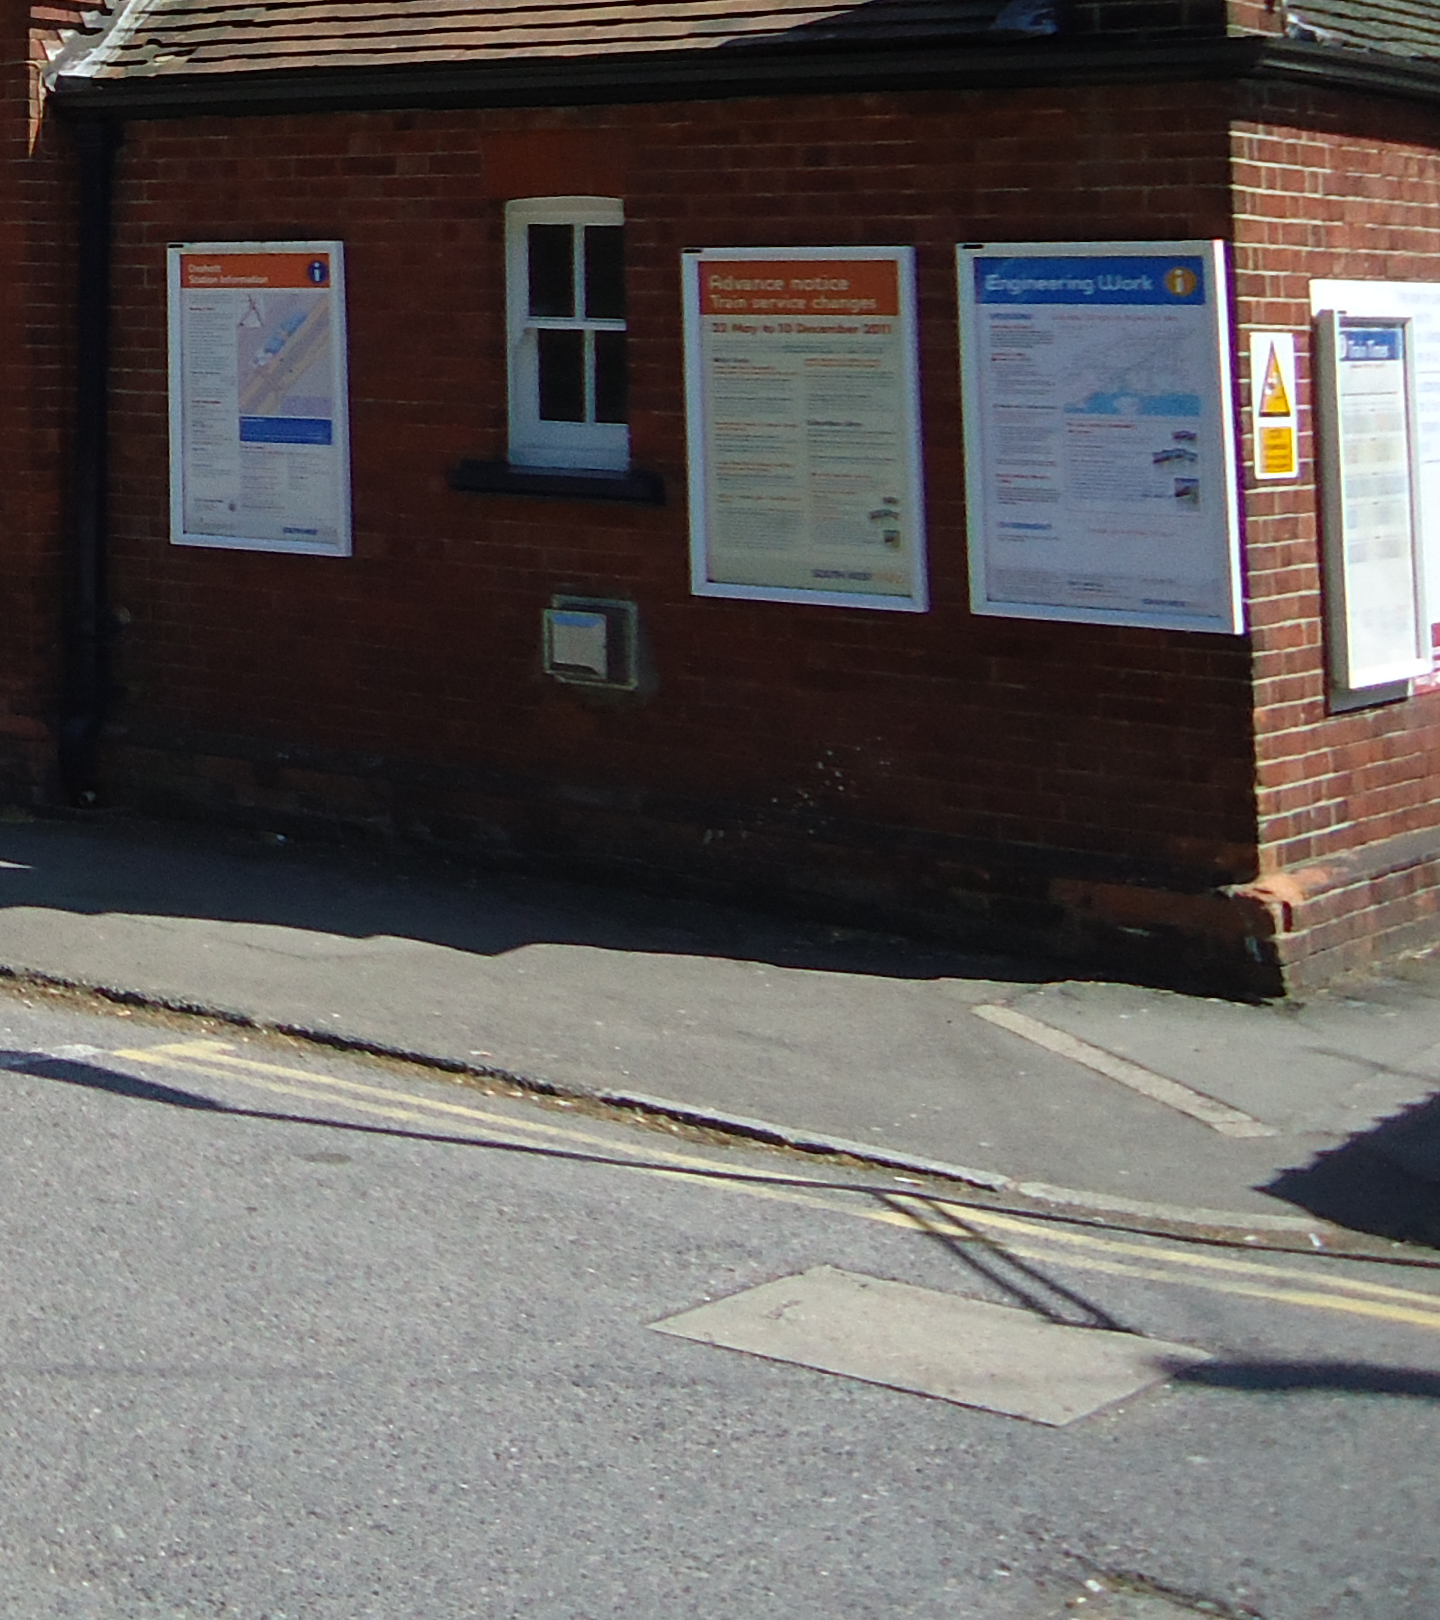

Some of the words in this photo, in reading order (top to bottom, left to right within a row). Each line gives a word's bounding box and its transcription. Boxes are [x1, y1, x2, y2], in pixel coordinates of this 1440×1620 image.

[709, 275, 785, 291] Advance
[790, 275, 850, 291] notice
[984, 274, 1094, 295] Engineering
[1098, 274, 1153, 291] Work
[711, 294, 748, 309] Train
[751, 295, 807, 309] service
[812, 295, 877, 313] changes
[732, 323, 758, 335] May
[763, 324, 776, 334] to
